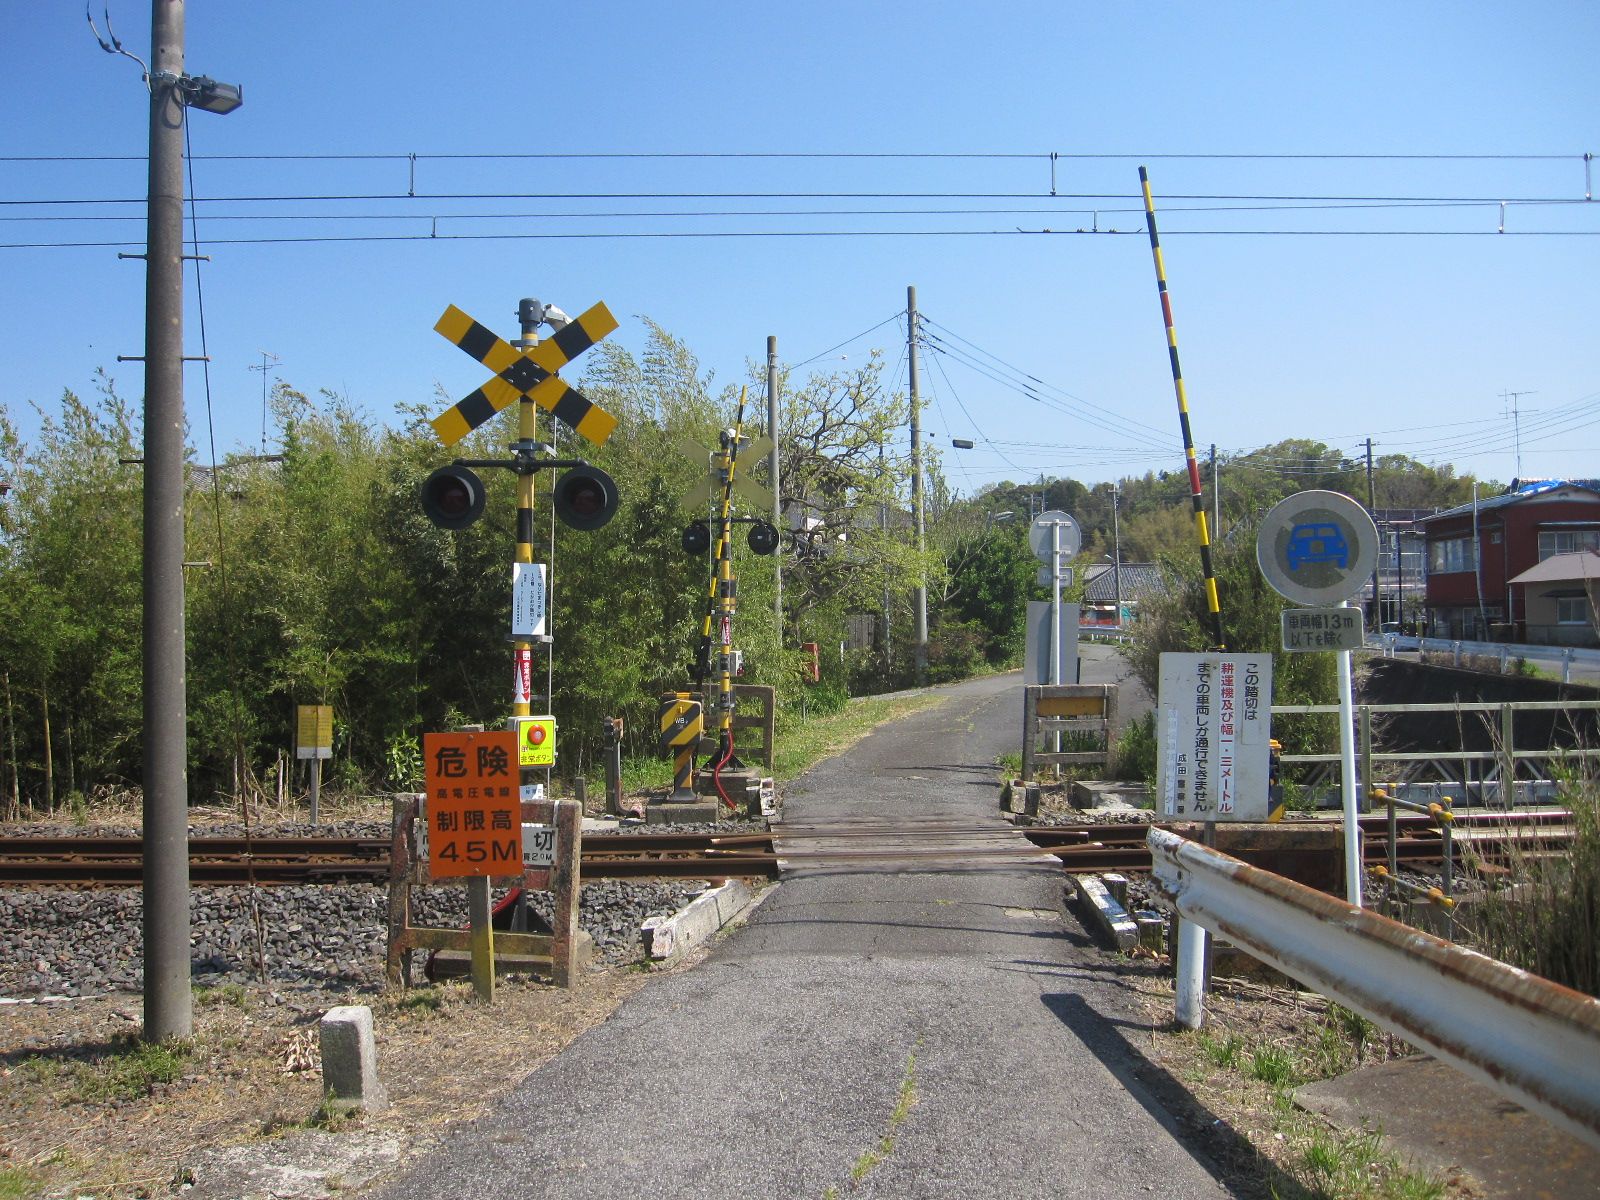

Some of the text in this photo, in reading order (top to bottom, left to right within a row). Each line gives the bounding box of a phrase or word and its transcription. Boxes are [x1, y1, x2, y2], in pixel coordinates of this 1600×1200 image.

[1290, 631, 1342, 647] 以下を除く
[1244, 662, 1259, 721] この踏切は
[1193, 662, 1210, 813] までの車両しか通行できません
[435, 745, 509, 778] 危険
[520, 754, 552, 763] 非常ボタン
[437, 809, 512, 832] 制限高
